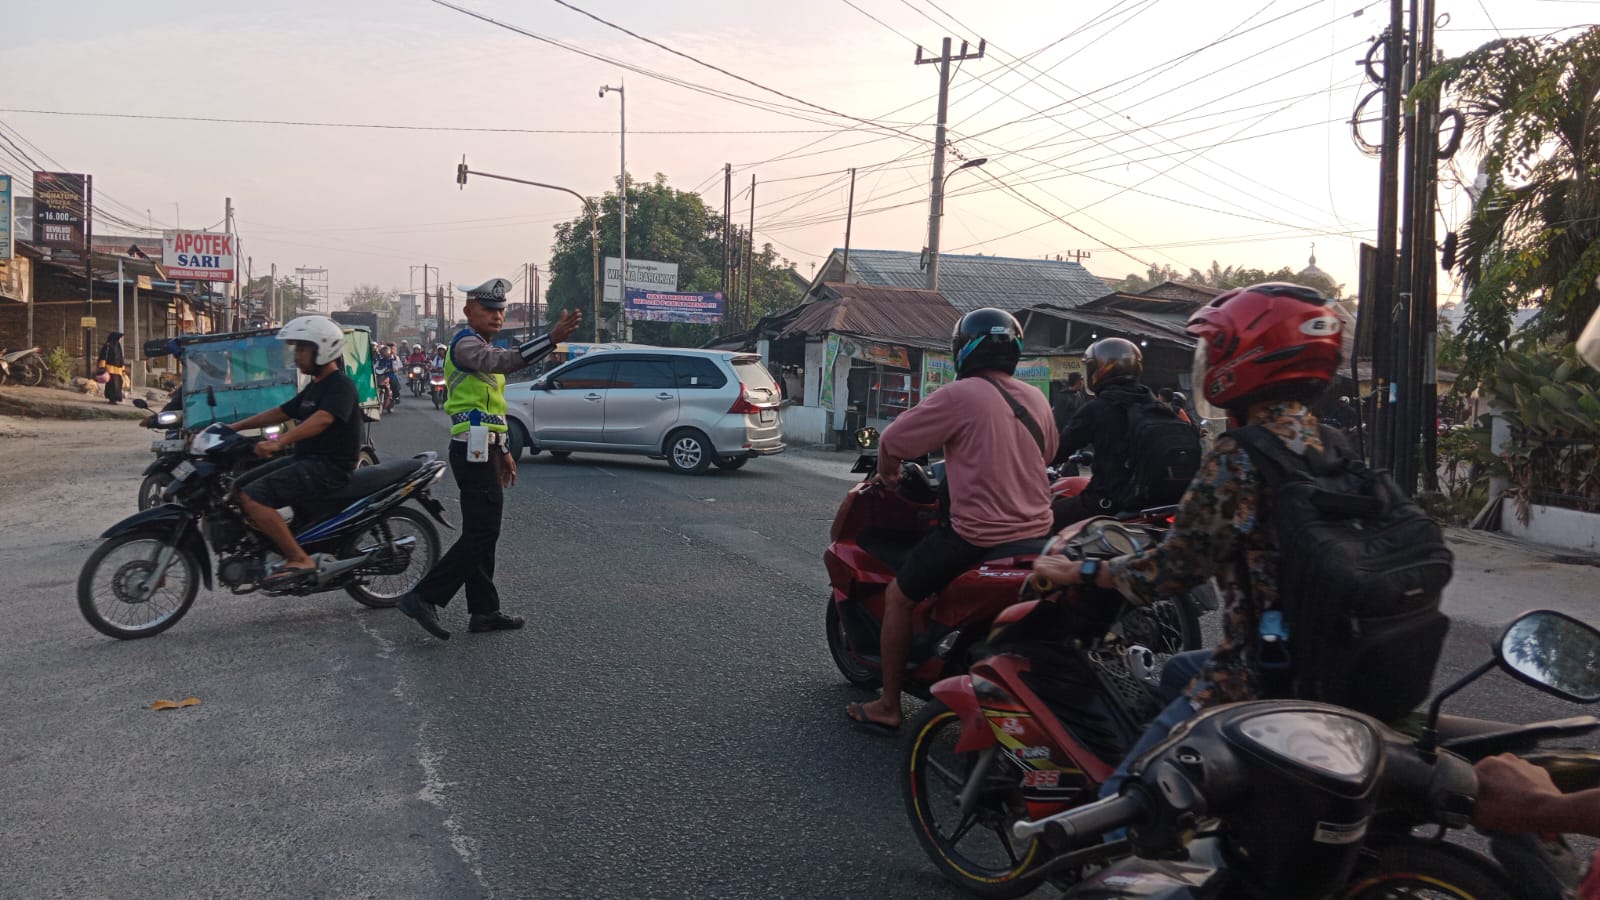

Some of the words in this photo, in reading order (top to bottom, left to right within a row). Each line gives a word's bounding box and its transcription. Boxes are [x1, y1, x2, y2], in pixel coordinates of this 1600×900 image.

[45, 211, 69, 221] 16.000
[175, 233, 231, 255] APOTEK
[178, 254, 219, 267] SARI
[638, 271, 676, 284] BAROKAH
